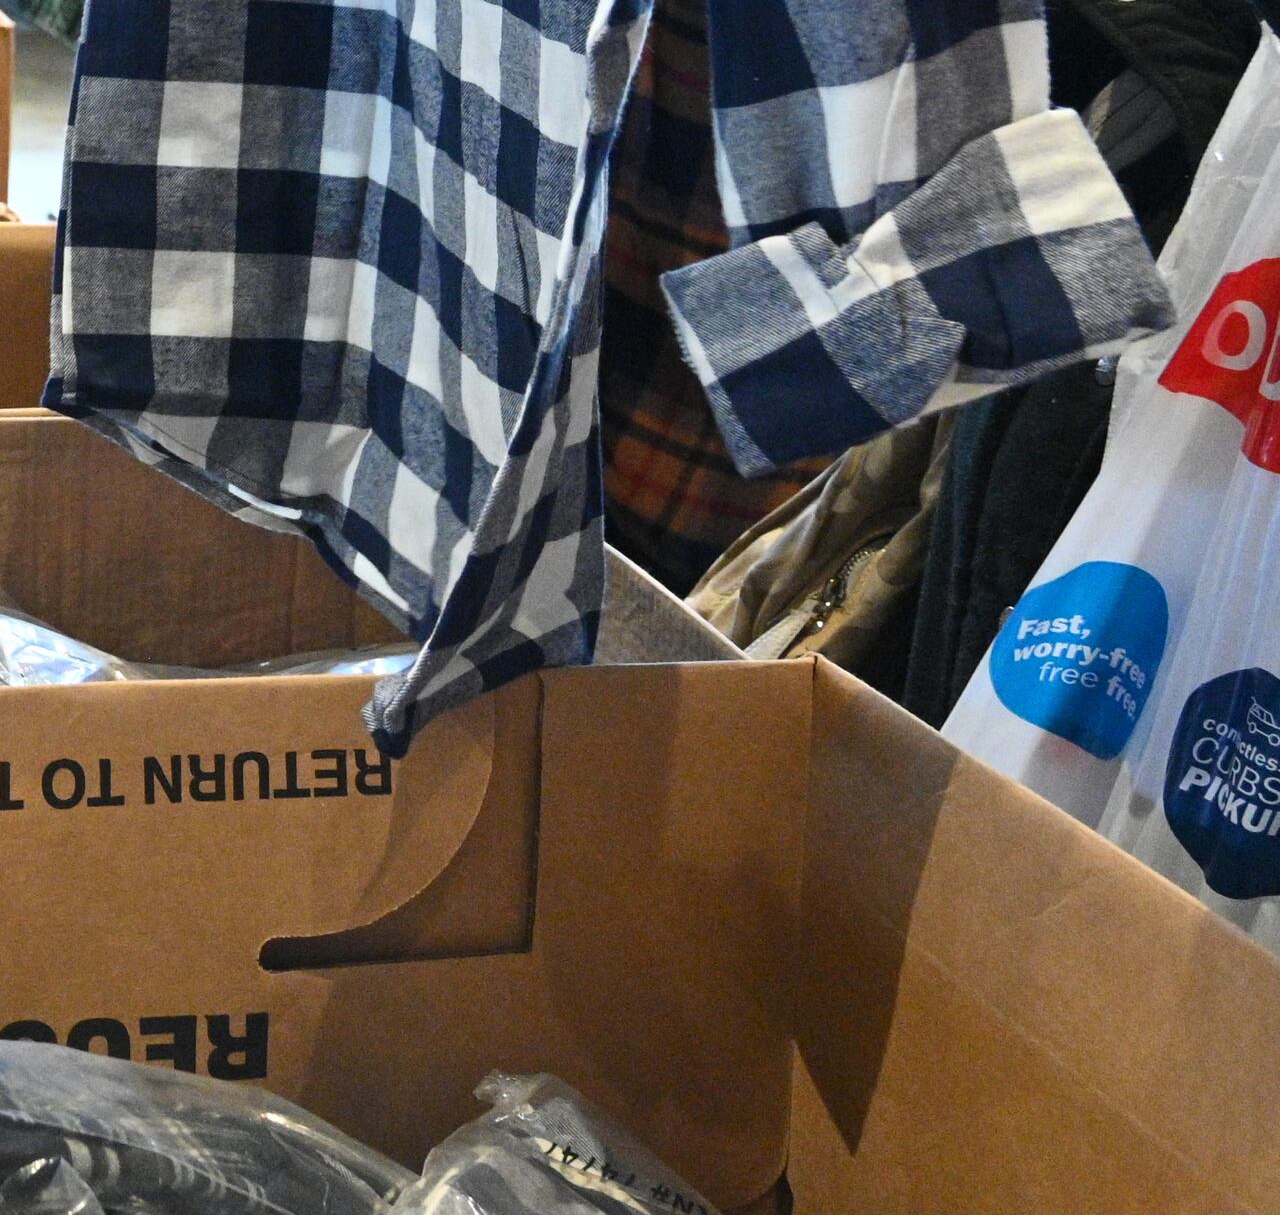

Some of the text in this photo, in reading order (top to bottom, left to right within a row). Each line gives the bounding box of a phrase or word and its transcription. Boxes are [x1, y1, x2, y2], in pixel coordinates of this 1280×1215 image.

[1016, 614, 1091, 639] Fast,
[1014, 641, 1146, 689] worry-free
[1039, 661, 1098, 688] free
[41, 758, 126, 810] TO
[143, 749, 393, 805] RETURN
